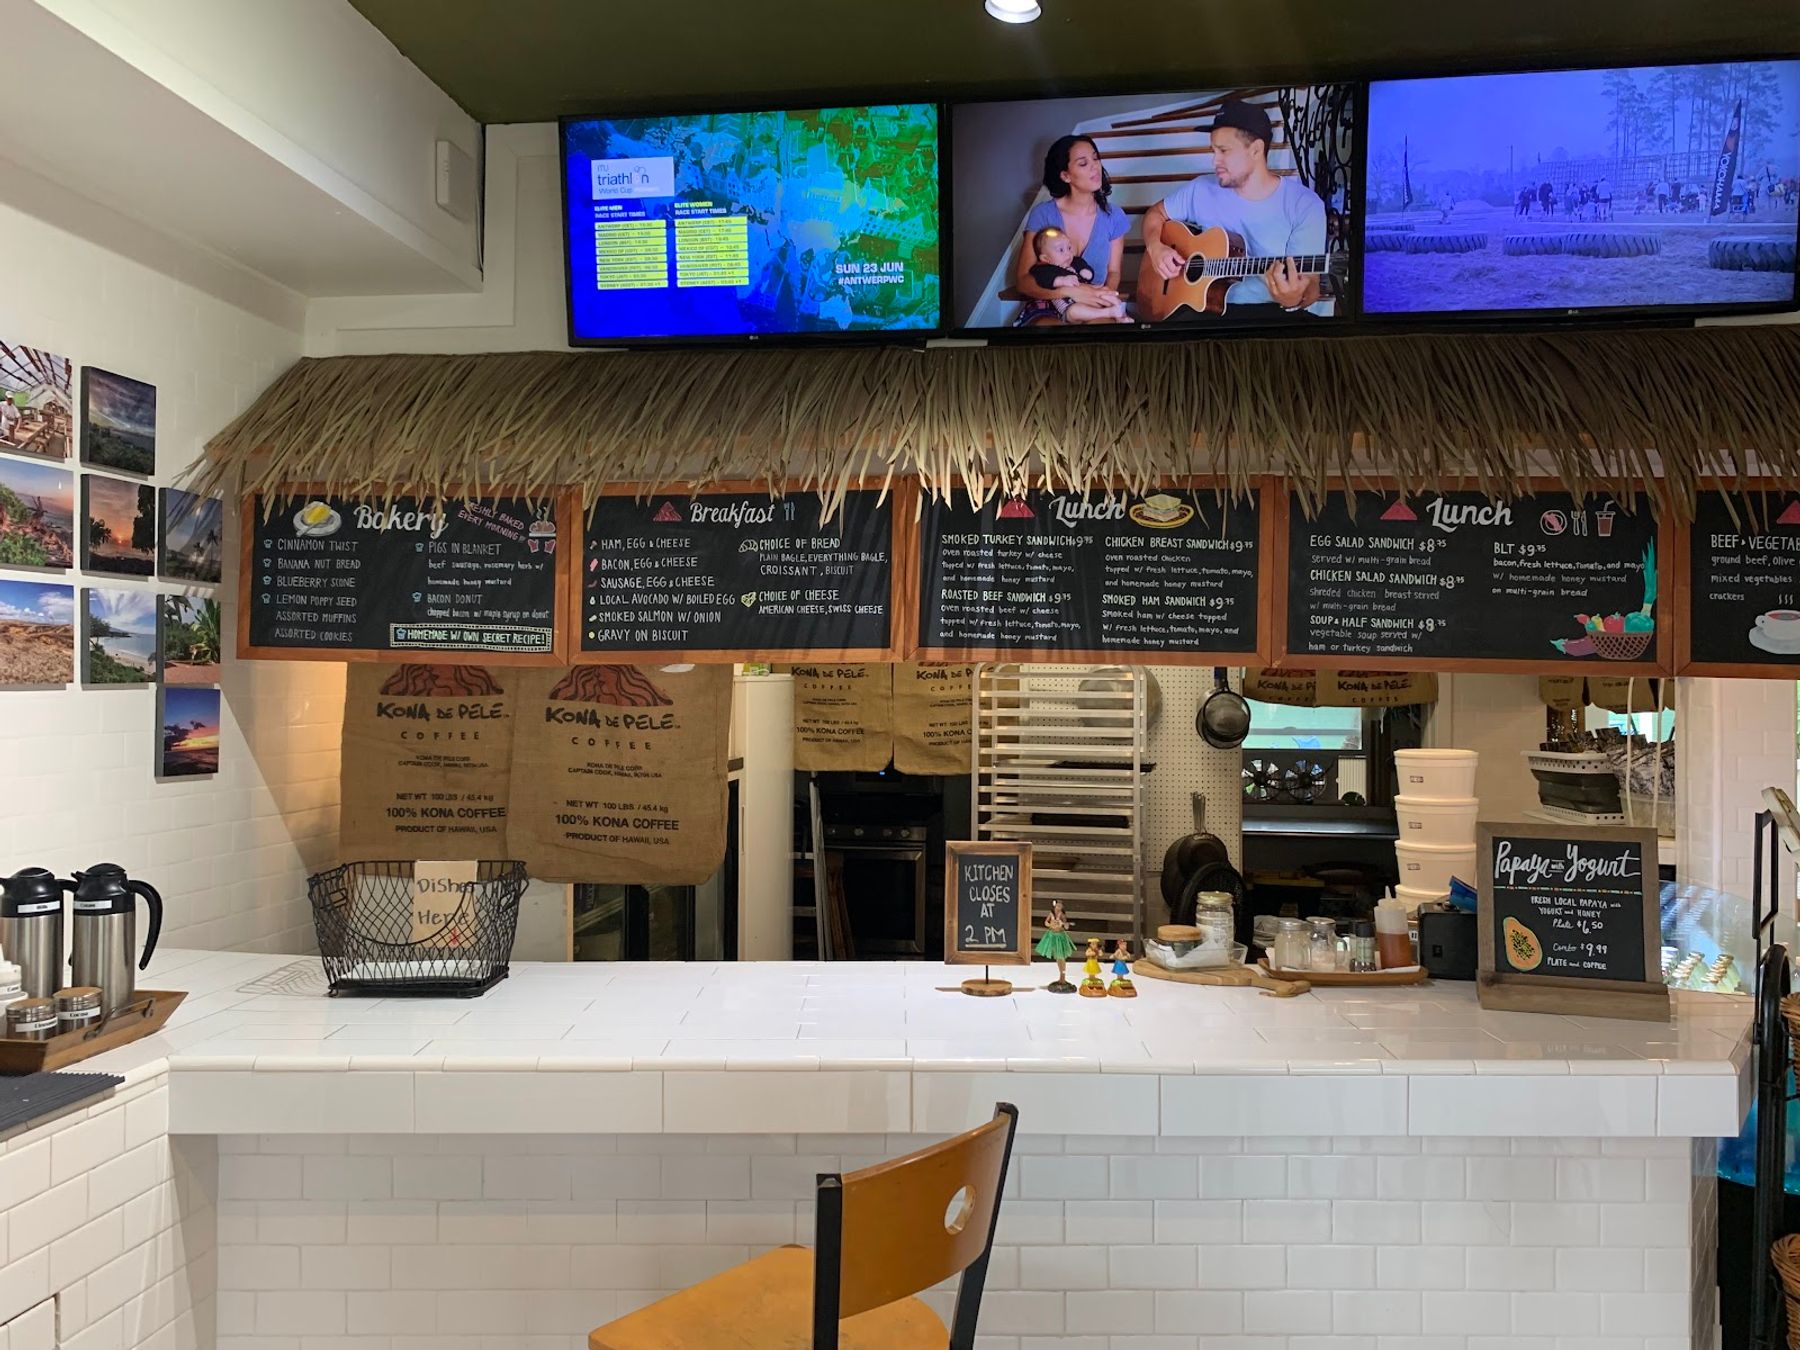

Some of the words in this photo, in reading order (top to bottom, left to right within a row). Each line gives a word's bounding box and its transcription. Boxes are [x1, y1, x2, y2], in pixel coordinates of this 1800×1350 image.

[598, 173, 649, 186] triathln
[1713, 152, 1732, 210] YOKOHAMA
[836, 263, 860, 274] SUN
[863, 263, 877, 273] 23
[880, 262, 903, 272] JUN
[838, 276, 904, 285] #ANTWERPWC
[690, 501, 776, 528] Breakfast
[1049, 496, 1125, 528] Lunch
[1426, 498, 1513, 533] Lunch
[354, 505, 448, 539] Bakery
[458, 510, 483, 526] EVERY
[485, 521, 519, 540] MORNING
[499, 513, 524, 530] BAKED
[277, 538, 325, 551] CINNAMON
[329, 541, 359, 551] TWIST
[627, 538, 646, 548] EGG
[656, 538, 691, 549] CHEESE
[759, 538, 790, 550] CHOICE
[796, 538, 807, 548] OF
[811, 538, 841, 549] BREAD
[942, 534, 979, 545] SMOKED
[983, 534, 1024, 546] TURKEY
[1026, 536, 1072, 546] SANDWICH
[1105, 536, 1144, 548] CHICKEN
[1150, 537, 1184, 549] BREAST
[1186, 539, 1229, 550] SANDWICH
[1310, 535, 1331, 547] EGG
[1335, 536, 1364, 548] SALAD
[1368, 537, 1414, 550] SANDWICH
[1711, 534, 1739, 548] BEEF
[428, 542, 447, 554] PIGS
[451, 542, 460, 554] IN
[462, 543, 502, 555] BLANKET
[1494, 542, 1515, 554] BLT
[277, 558, 310, 569] BANANA
[314, 559, 331, 569] NUT
[336, 559, 361, 569] BREAD
[601, 558, 634, 571] BACON,
[634, 557, 652, 570] EGG
[661, 557, 698, 567] CHEESE
[759, 553, 778, 562] PLAIN
[781, 553, 807, 563] BAGLE,
[808, 552, 858, 563] EVERYTHING
[861, 553, 888, 563] BAGLE,
[1711, 555, 1741, 566] ground
[1745, 555, 1771, 567] beef,
[825, 565, 854, 575] BISCUIT
[277, 575, 328, 588] BLUEBERRY
[331, 577, 356, 587] SCONE
[600, 577, 645, 589] SAUSAGE,
[646, 576, 667, 587] EGG
[675, 576, 715, 587] CHEESE
[1310, 569, 1351, 582] CHICKEN
[1356, 571, 1385, 583] SALAD
[1389, 573, 1437, 585] SANDWICH
[1711, 573, 1740, 583] mixed
[1744, 575, 1792, 586] vegetables
[276, 594, 307, 605] LEMON
[311, 595, 334, 606] POPPY
[336, 597, 357, 607] SEED
[427, 594, 451, 604] BACON
[456, 594, 483, 604] DONUT
[600, 594, 629, 605] LOCAL
[631, 594, 669, 605] AVOCADO
[672, 594, 683, 605] W/
[686, 594, 715, 605] BOILED
[716, 594, 735, 605] EGG
[759, 590, 788, 602] CHOICE
[791, 590, 801, 600] OF
[805, 590, 840, 601] CHEESE
[941, 589, 979, 600] ROASTED
[983, 591, 1003, 601] BEEF
[1007, 592, 1046, 603] SANDWICH
[1102, 594, 1136, 606] SMOKED
[1142, 596, 1160, 606] HAM
[1164, 596, 1206, 606] SANDWICH
[758, 605, 795, 615] AMERICAN
[797, 605, 828, 615] CHEESE,
[828, 604, 851, 613] SWISS
[855, 605, 883, 615] CHEESE
[276, 611, 319, 622] ASSORTED
[322, 612, 357, 623] MUFFINS
[599, 612, 635, 622] SMOKED
[638, 610, 673, 623] SALMON
[678, 611, 691, 623] W/
[694, 611, 721, 623] ONION
[1310, 615, 1333, 625] SOUP
[1342, 617, 1368, 628] HALF
[1371, 618, 1414, 629] SANDWICH
[275, 628, 316, 639] ASSORTED
[320, 630, 353, 642] COOKIES
[407, 629, 448, 640] HOMEMADE
[463, 631, 479, 642] OWN
[483, 632, 511, 643] SECRET
[512, 633, 545, 645] RECIPE!
[598, 629, 631, 642] GRAVY
[636, 630, 648, 641] ON
[652, 630, 688, 641] BISCUIT
[1338, 680, 1368, 692] KONA
[376, 702, 430, 721] KONA
[436, 708, 453, 719] DE
[458, 702, 504, 720] PELE
[545, 707, 600, 728] KONA
[605, 716, 619, 728] DE
[623, 713, 674, 730] PELE
[400, 731, 480, 740] COFFEE
[571, 737, 652, 750] COFFEE
[555, 814, 589, 826] 100%
[593, 816, 629, 828] KONA
[633, 818, 679, 830] COFFEE
[565, 832, 608, 842] PRODUCT
[609, 835, 620, 843] OF
[653, 837, 670, 845] USA
[1494, 841, 1552, 885] Papaya
[1551, 862, 1565, 870] with
[1564, 843, 1641, 883] Yogurt
[964, 864, 1014, 882] KITCHEN
[969, 884, 1011, 903] CLOSES
[1531, 896, 1551, 905] FRESH
[1554, 897, 1577, 907] LOCAL
[1580, 898, 1607, 909] PAPAYA
[980, 903, 995, 918] AT
[1538, 907, 1563, 915] YOGURT
[1577, 909, 1601, 918] HONEY
[1552, 918, 1574, 929] Plate
[1577, 920, 1604, 934] $6.50
[965, 924, 979, 943] 2
[984, 926, 1006, 944] PM
[1580, 942, 1607, 957] $9.99
[1547, 957, 1567, 966] PLATE
[1583, 962, 1607, 970] COFFEE
